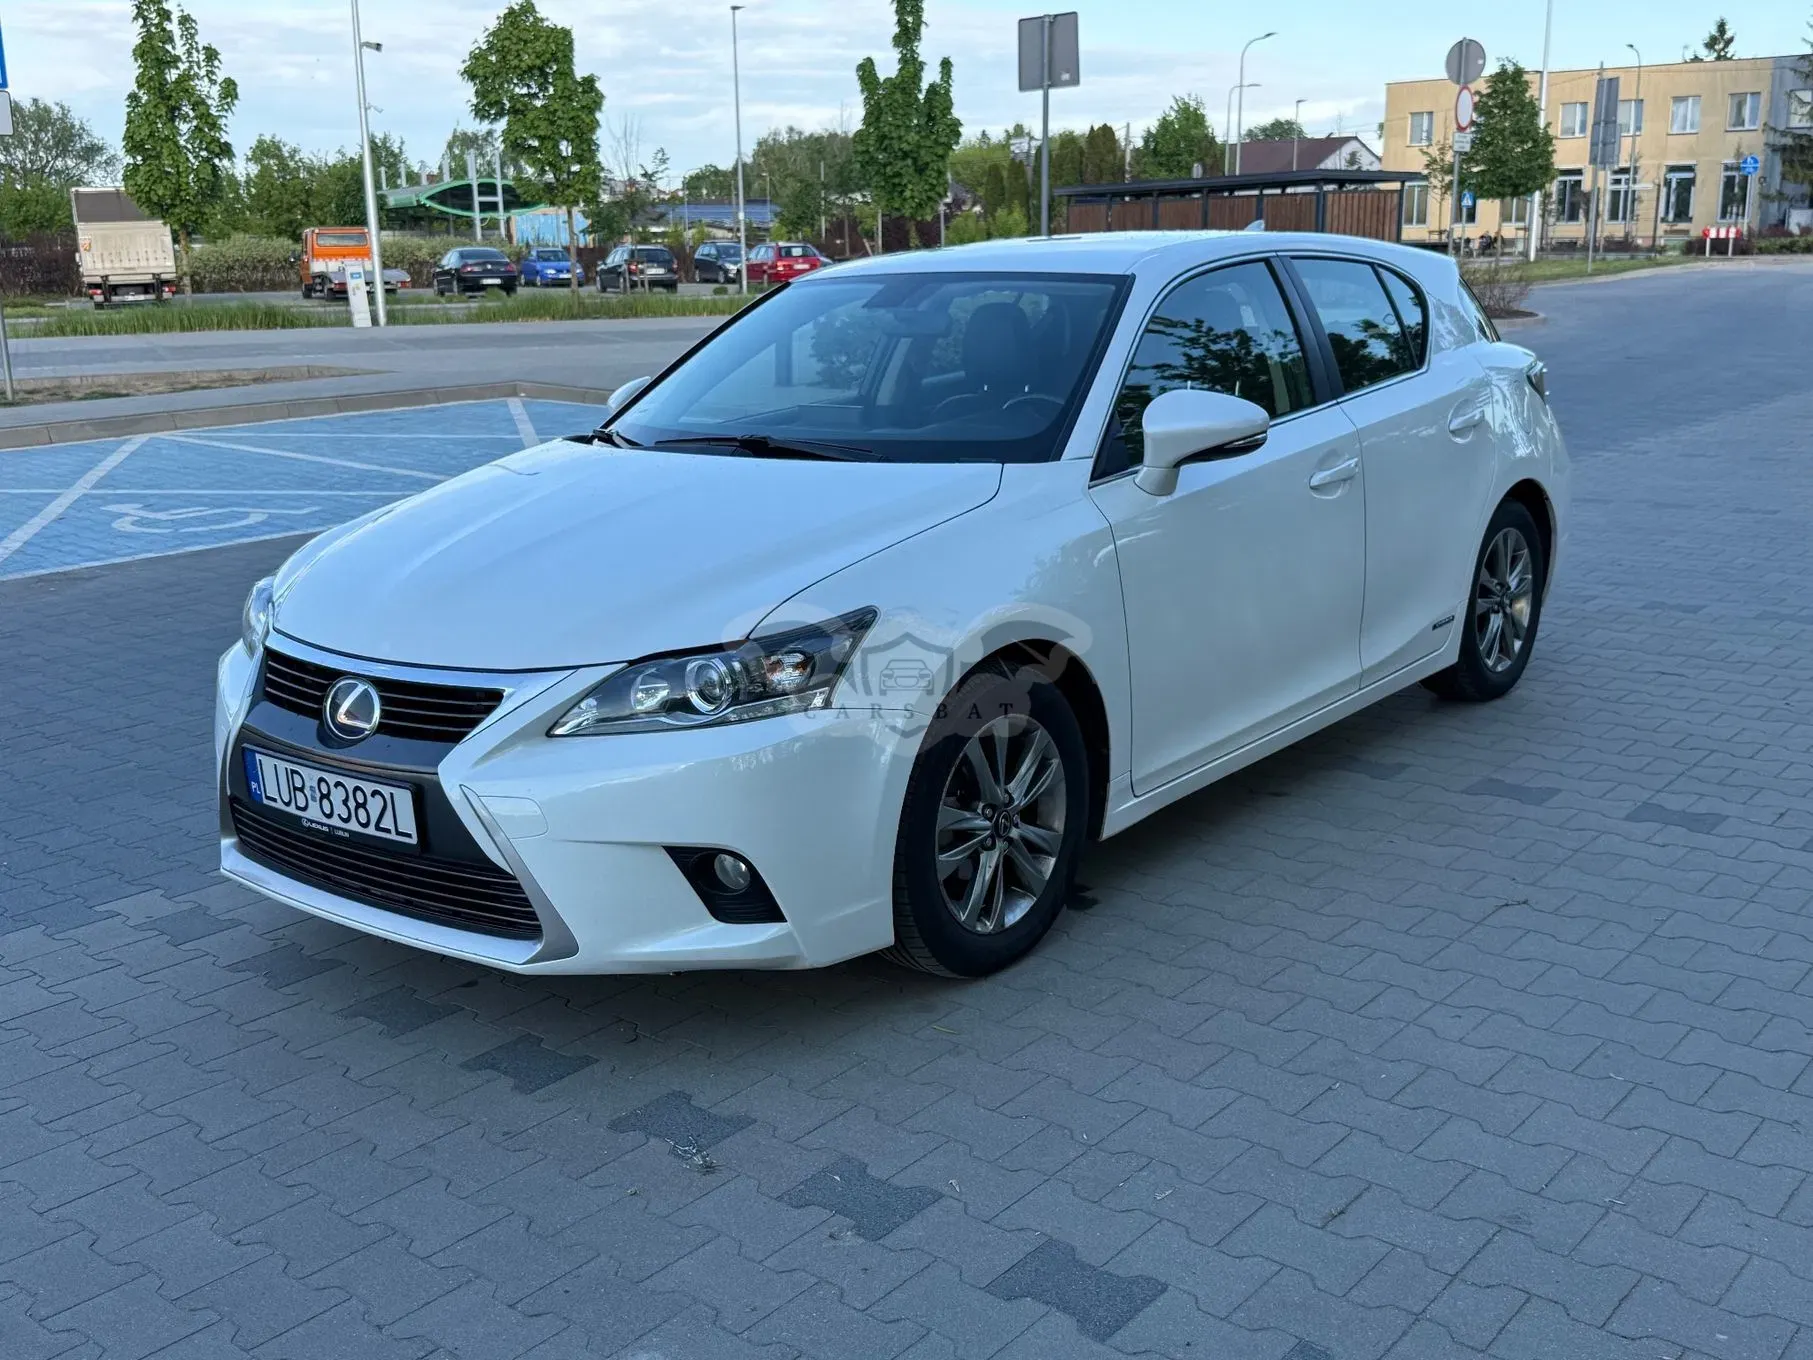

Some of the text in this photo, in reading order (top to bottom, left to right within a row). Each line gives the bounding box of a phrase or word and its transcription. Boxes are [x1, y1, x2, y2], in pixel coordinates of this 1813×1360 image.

[251, 781, 261, 794] PL
[258, 758, 413, 839] LUB 8382L
